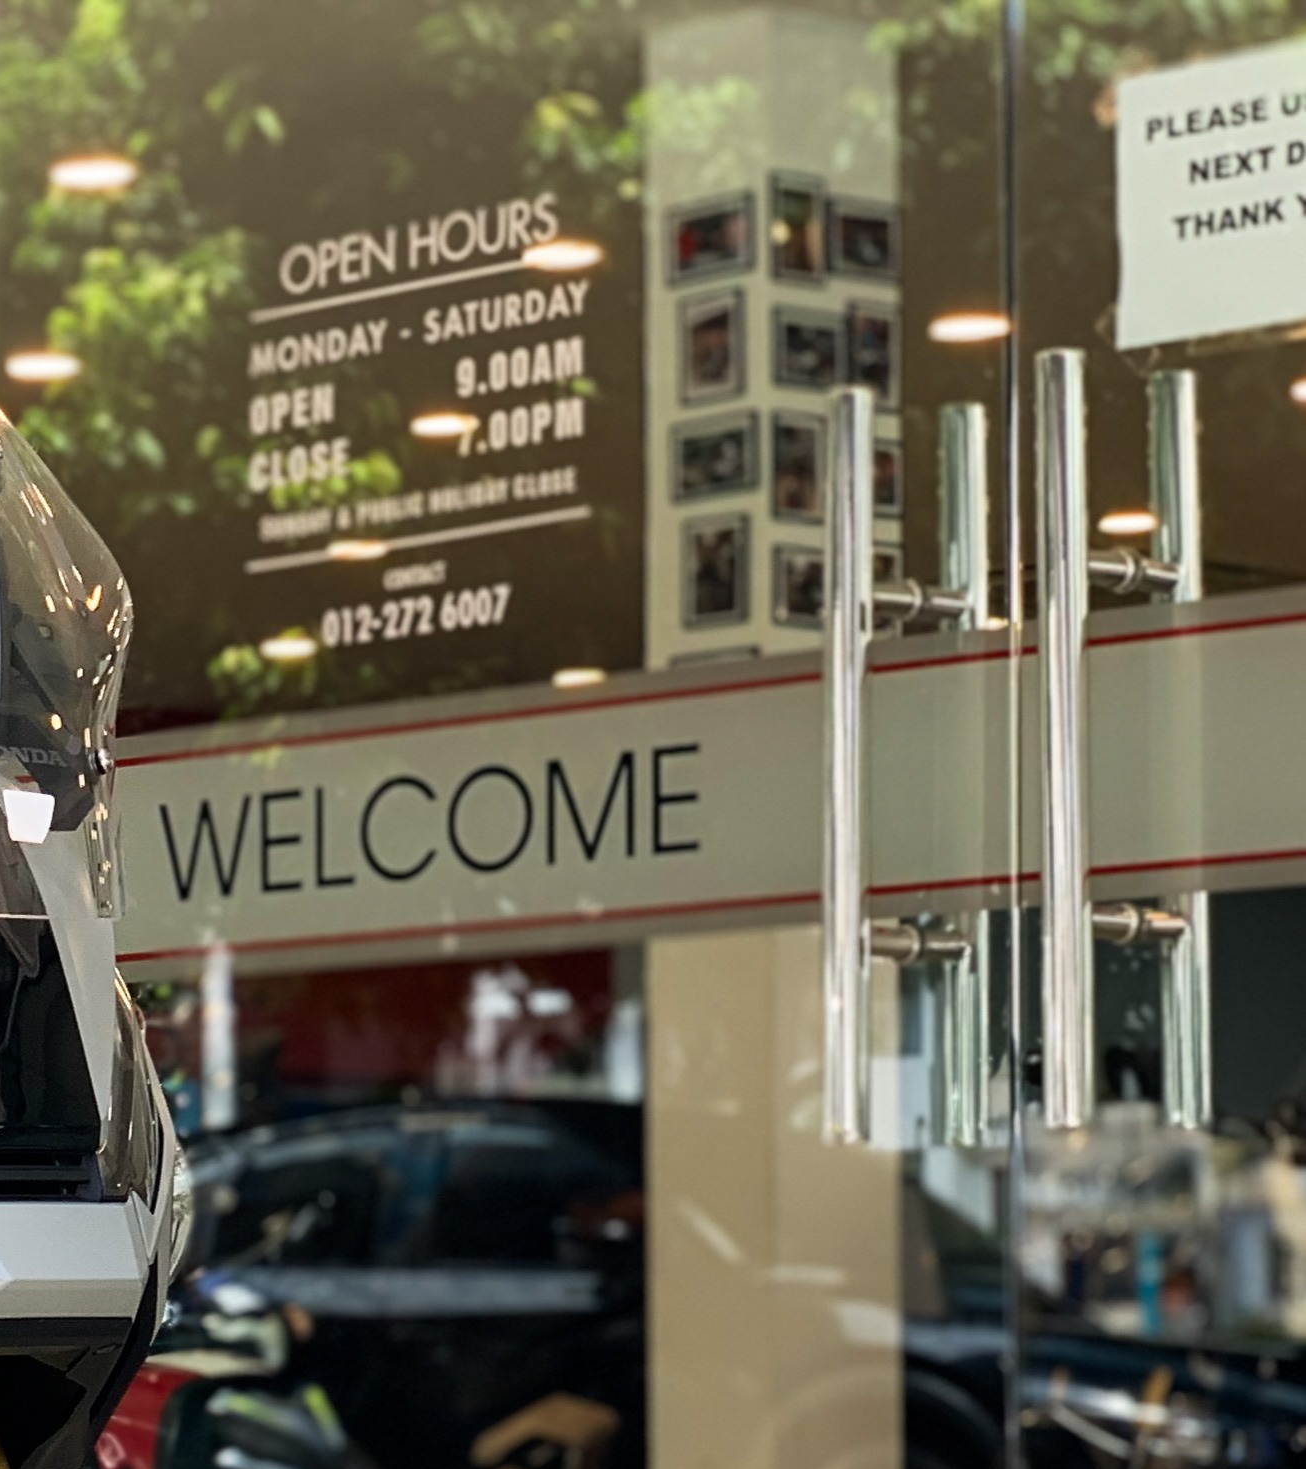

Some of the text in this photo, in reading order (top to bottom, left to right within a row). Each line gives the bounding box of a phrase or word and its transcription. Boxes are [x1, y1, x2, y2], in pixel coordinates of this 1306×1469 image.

[1145, 92, 1306, 141] PLEASE U
[1190, 146, 1275, 184] NEXT
[279, 194, 560, 293] OPEN HOURS
[1172, 198, 1285, 240] THANK
[247, 319, 389, 377] MONDAY
[422, 281, 589, 344] SATURDAY
[248, 337, 584, 435] OPEN 9.00AM
[249, 438, 351, 494] CLOSE
[321, 584, 511, 648] 012-272 6007
[159, 743, 700, 901] WELCOME
